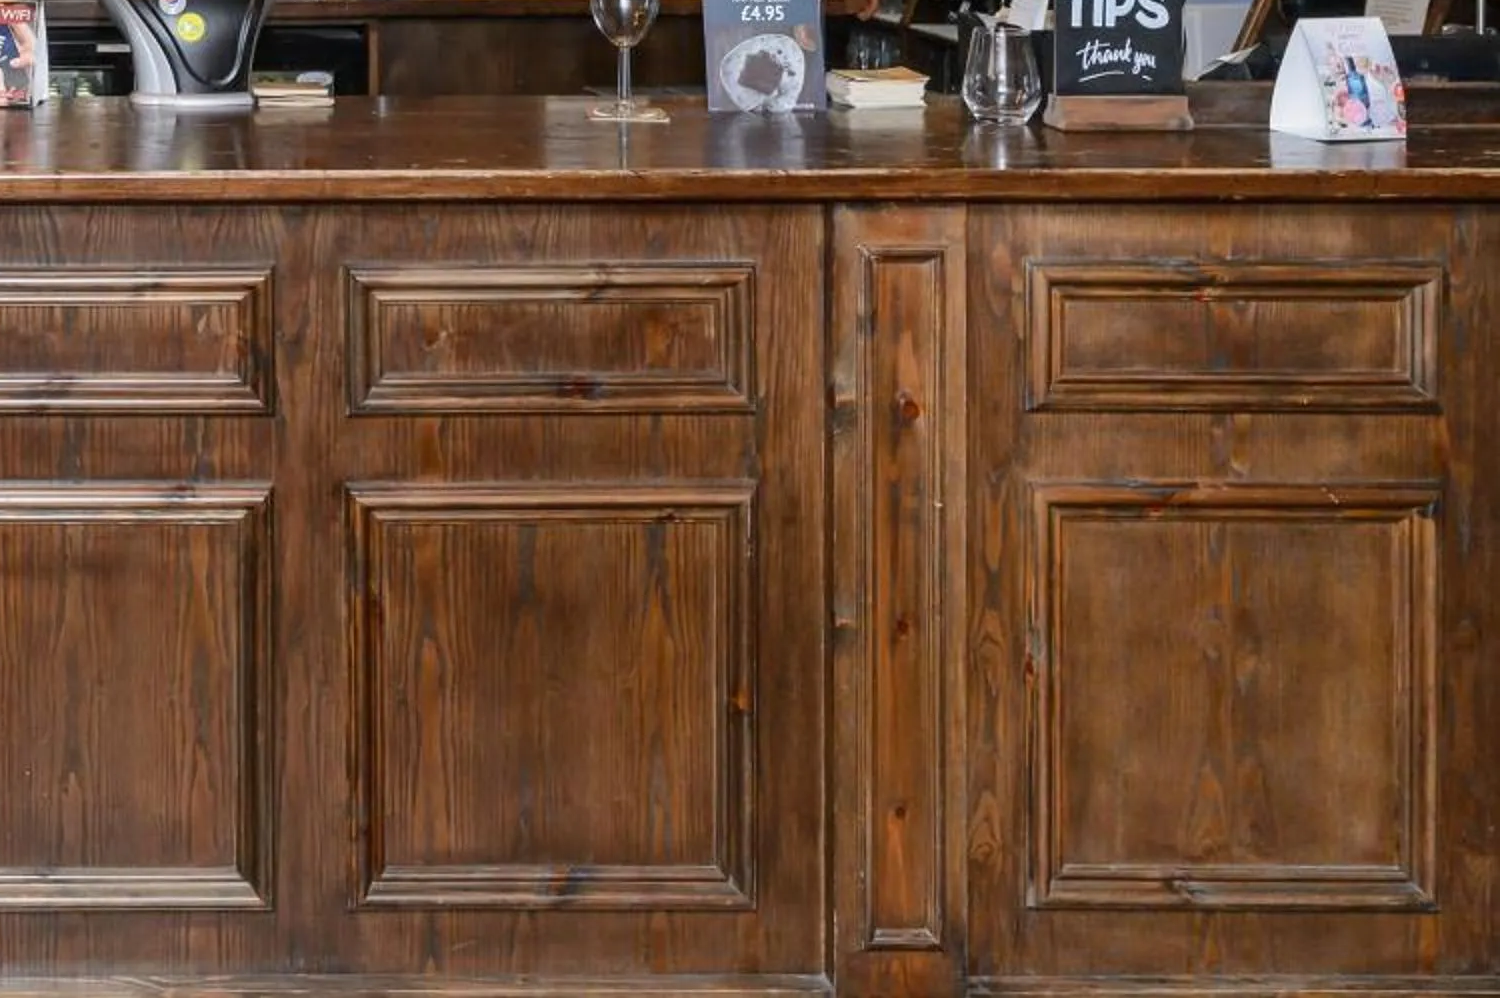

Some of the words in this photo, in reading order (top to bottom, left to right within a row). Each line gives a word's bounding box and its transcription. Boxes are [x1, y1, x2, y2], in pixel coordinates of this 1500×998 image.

[741, 5, 786, 22] £4.95
[1076, 36, 1132, 71] thank
[1132, 51, 1157, 75] you
